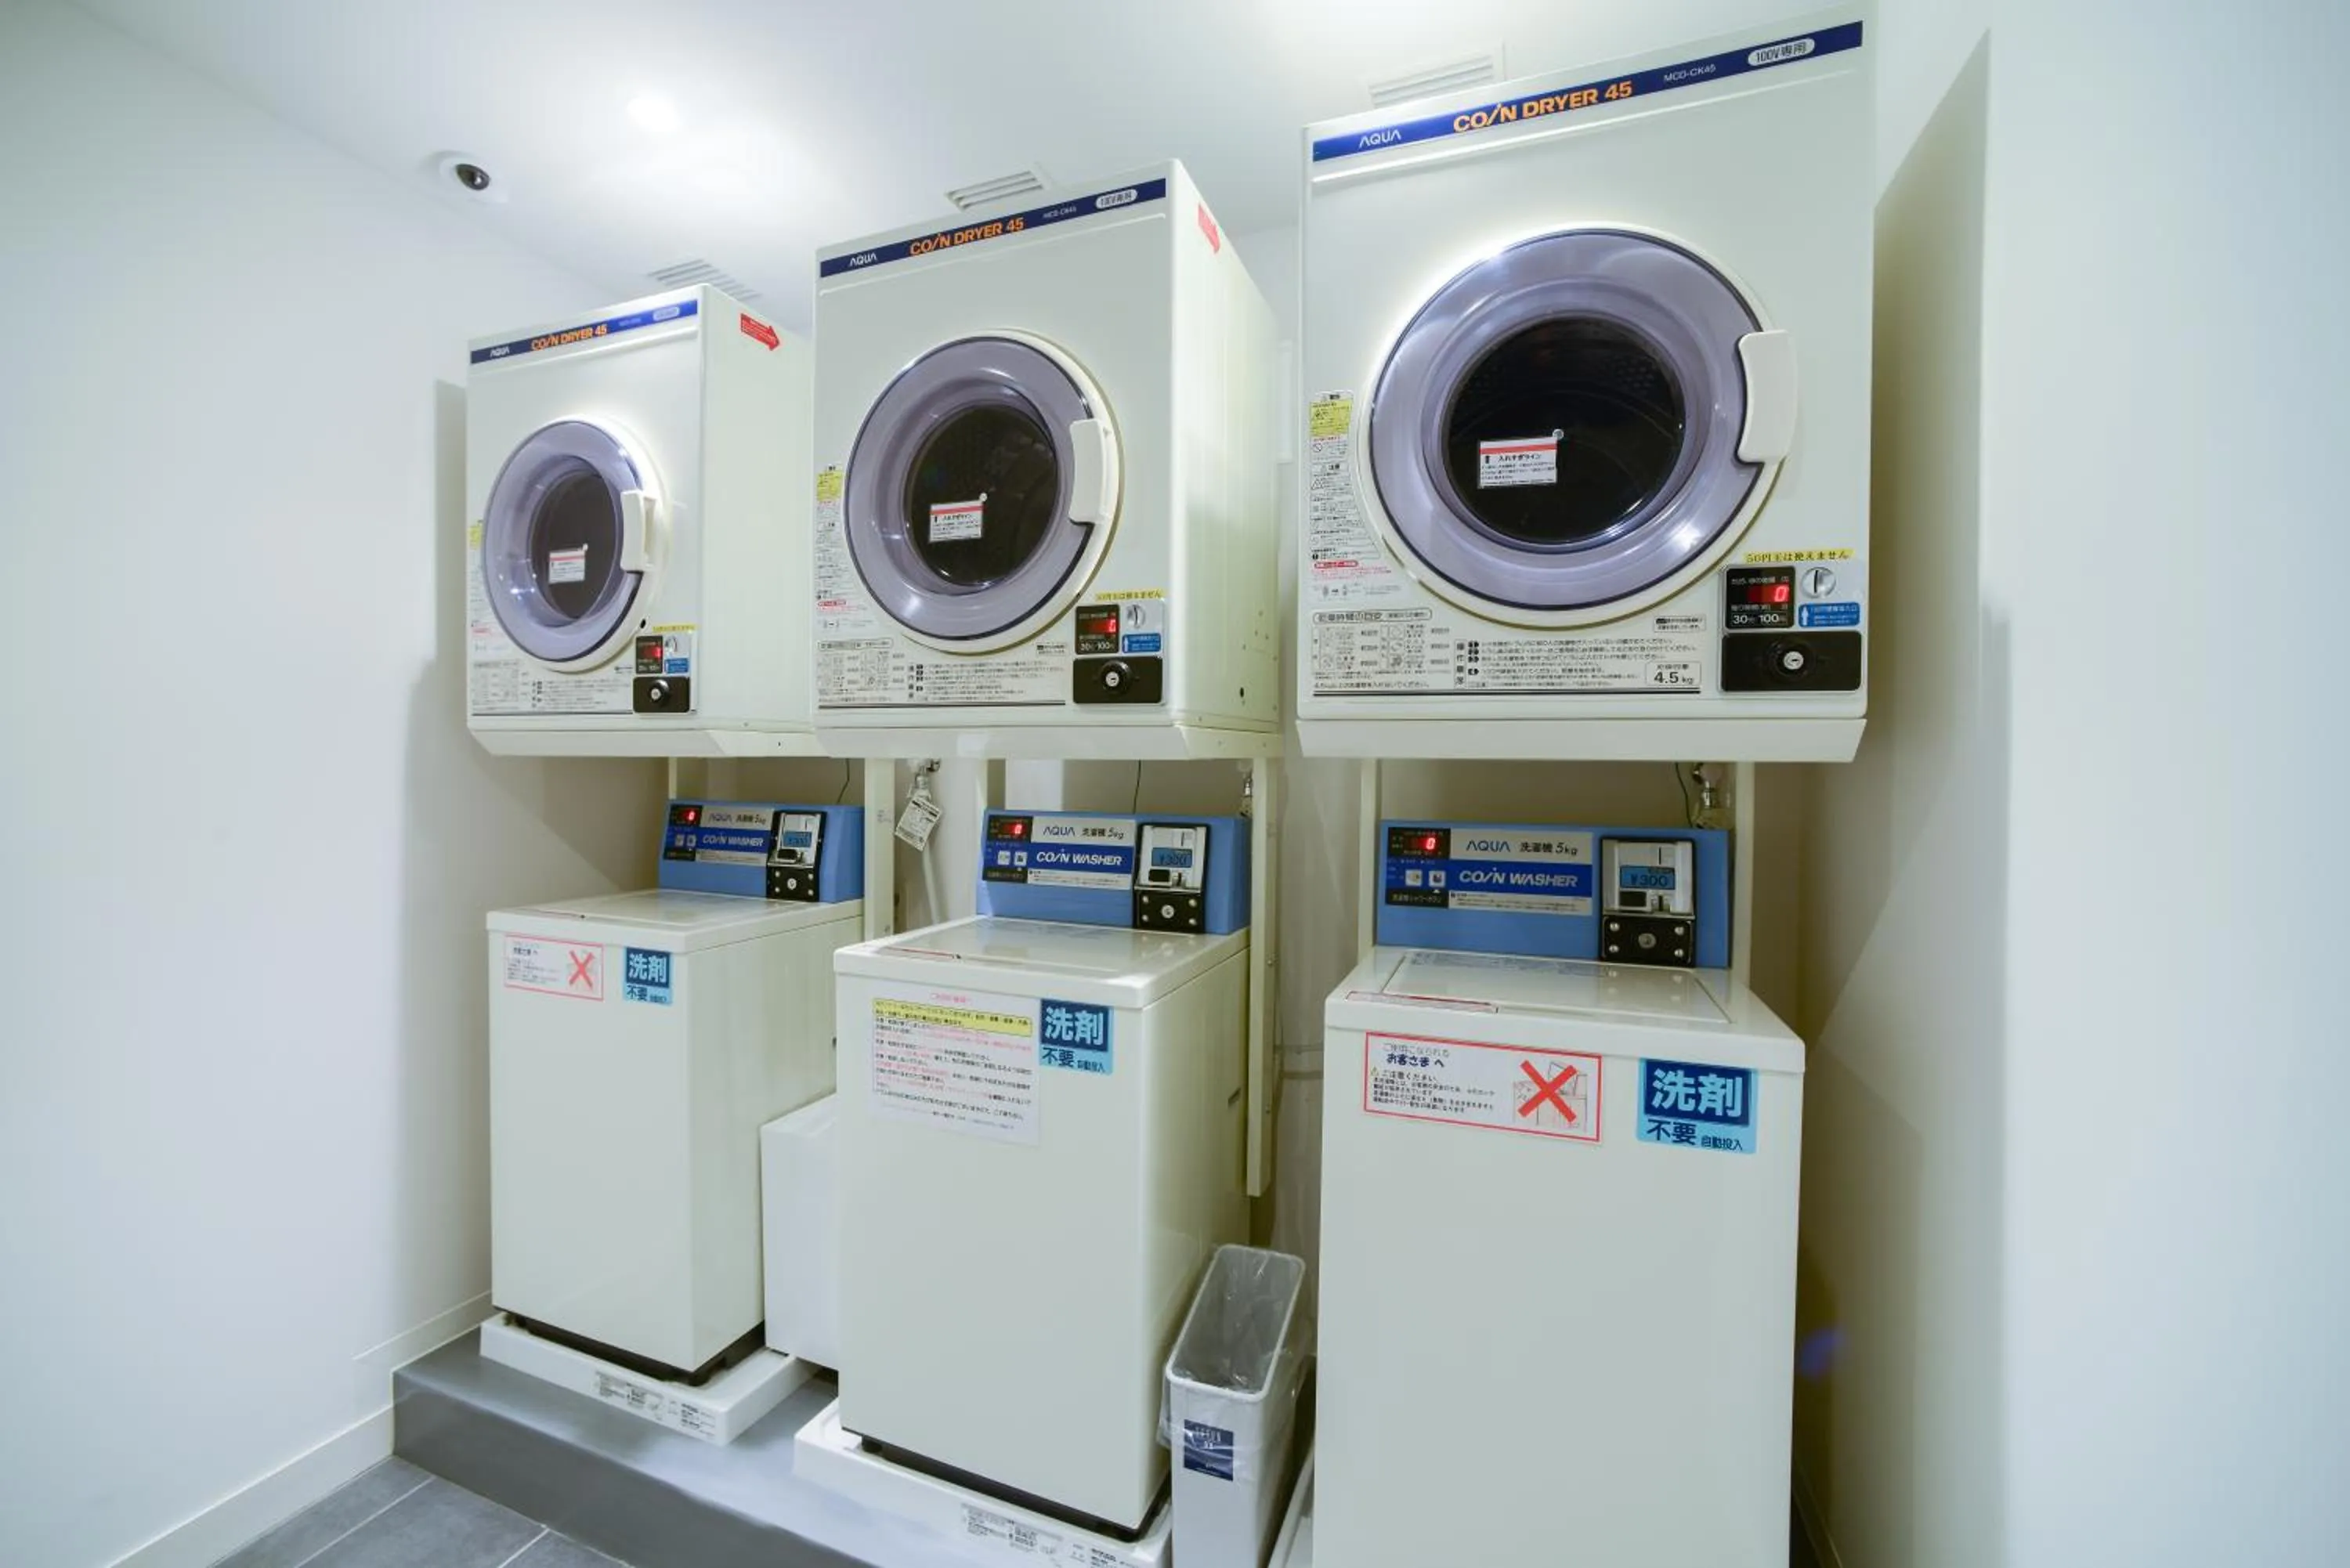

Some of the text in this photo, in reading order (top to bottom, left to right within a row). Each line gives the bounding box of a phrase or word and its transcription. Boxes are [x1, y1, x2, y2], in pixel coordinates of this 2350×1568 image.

[1359, 130, 1401, 147] AQUA
[1522, 88, 1599, 118] DRYER
[1604, 81, 1632, 100] 45
[849, 252, 877, 267] AQUA
[955, 222, 1002, 246] DRYER
[1007, 217, 1025, 233] 45
[561, 327, 593, 345] DRYER
[595, 323, 607, 336] 45
[1774, 586, 1789, 602] 0
[1108, 619, 1116, 632] 0
[1654, 671, 1679, 684] 4.5
[1043, 826, 1076, 836] AQUA
[1426, 836, 1436, 850] 0
[1466, 840, 1578, 856] AQUA 洗濯機 5kg
[1072, 854, 1123, 866] WASHER
[1509, 873, 1578, 887] WASHER
[629, 953, 666, 984] 洗剤
[627, 985, 647, 1002] 不要
[1045, 1007, 1104, 1046] 洗剤
[1042, 1047, 1074, 1068] 不要
[1651, 1068, 1743, 1118] 洗剤
[1647, 1118, 1743, 1151] 不要 自動投入
